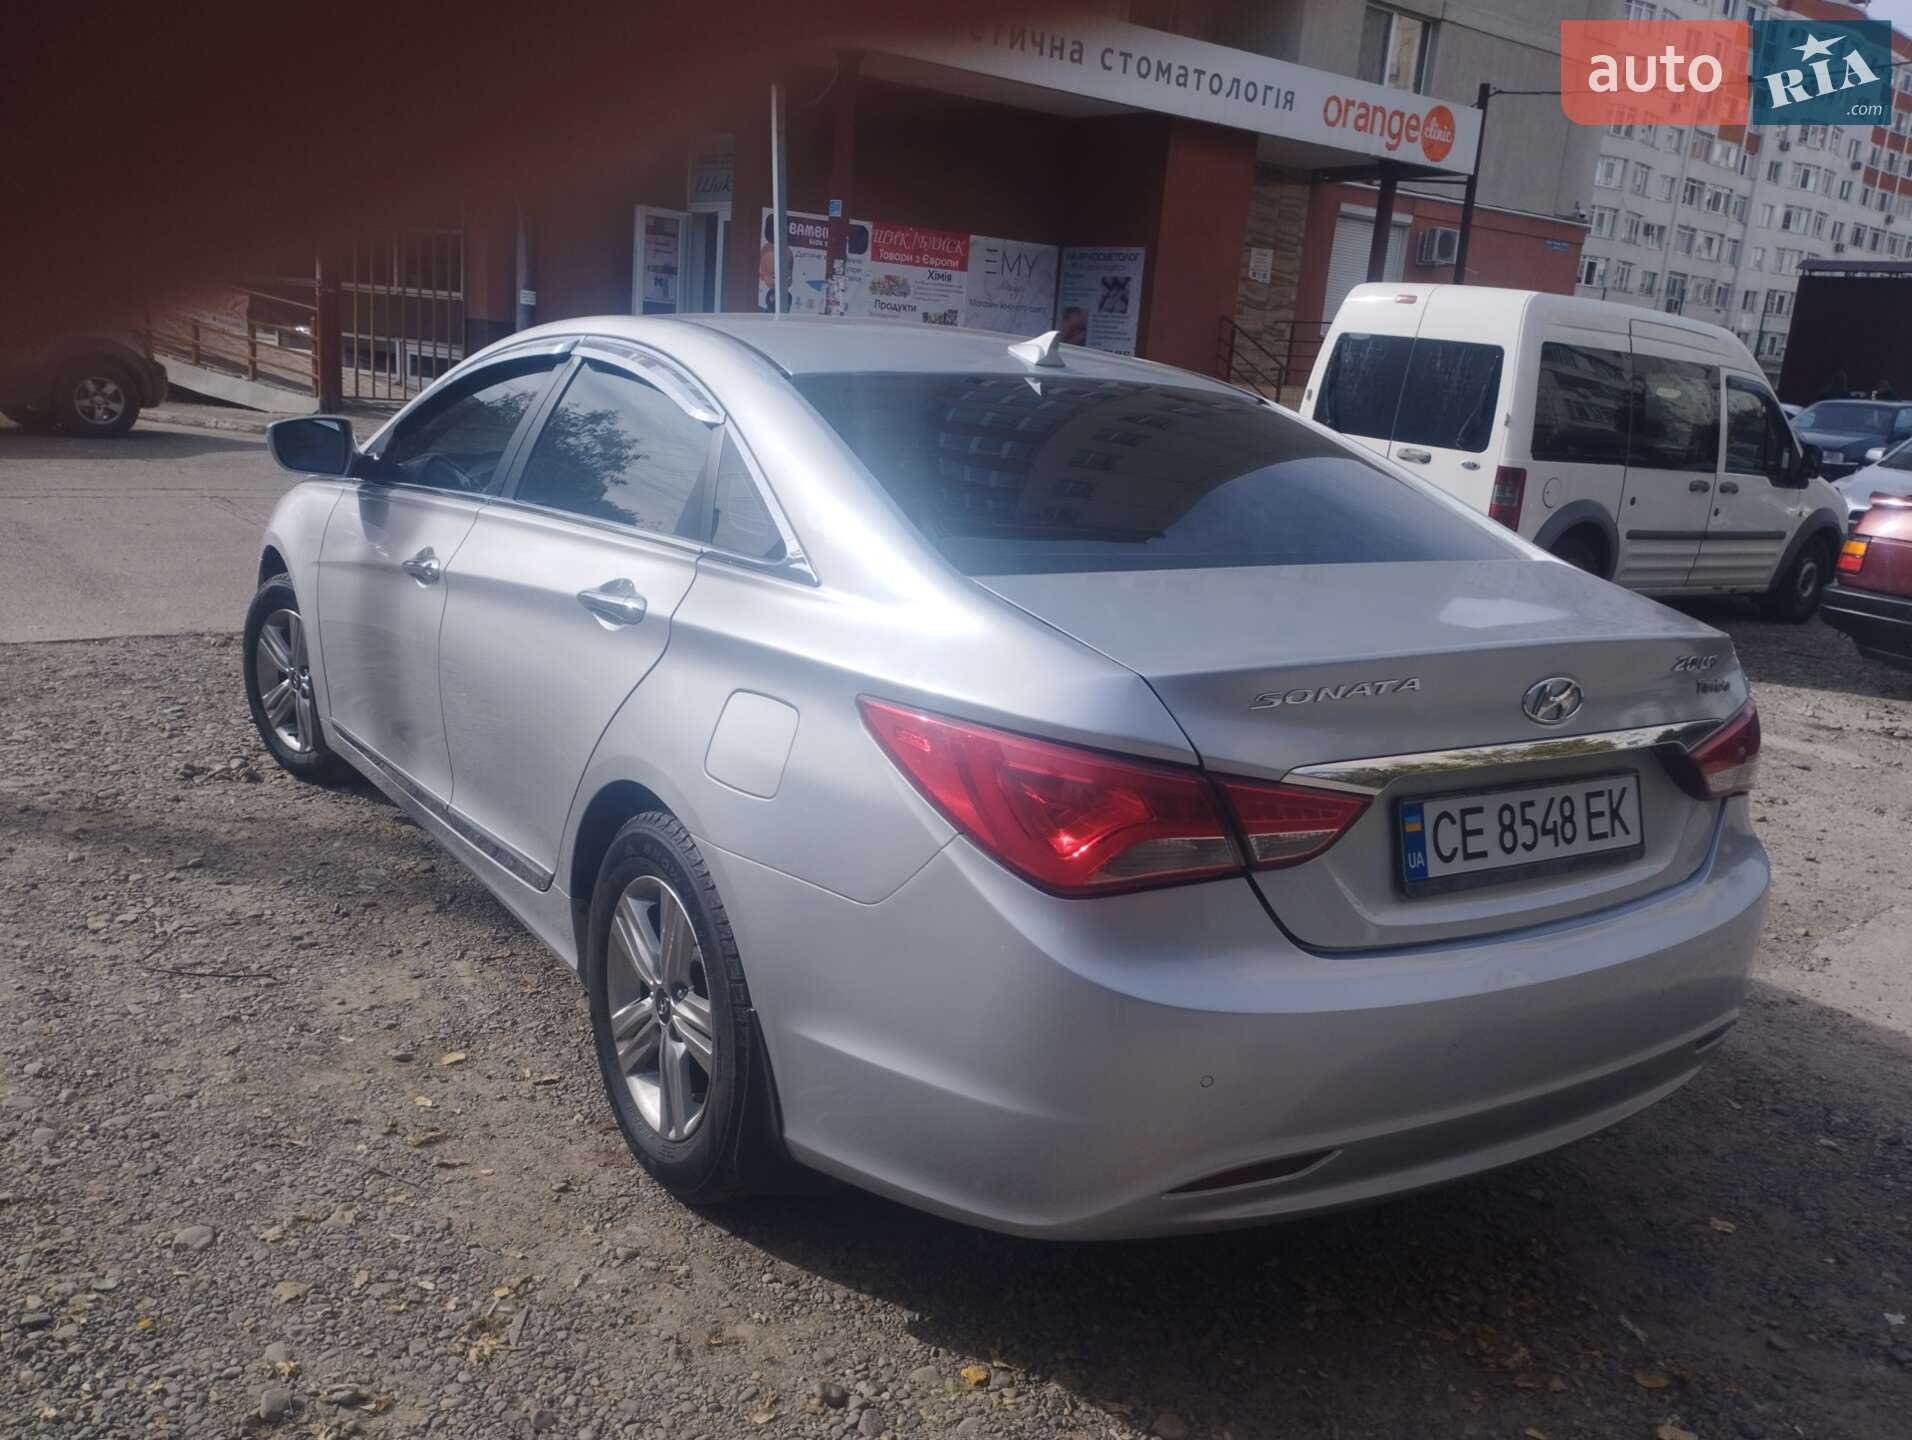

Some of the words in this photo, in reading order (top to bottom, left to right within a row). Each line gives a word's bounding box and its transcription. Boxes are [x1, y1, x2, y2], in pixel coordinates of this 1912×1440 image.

[1100, 47, 1296, 111] стоматологія
[1323, 95, 1421, 151] orange
[880, 248, 913, 265] Товари
[922, 253, 959, 268] Європи
[927, 269, 952, 282] Хімія
[874, 299, 917, 313] Продукти
[1250, 677, 1421, 710] SONATA
[1432, 806, 1488, 864] CE
[1498, 795, 1577, 855] 8548
[1584, 787, 1631, 842] EK
[1408, 851, 1425, 869] UA
